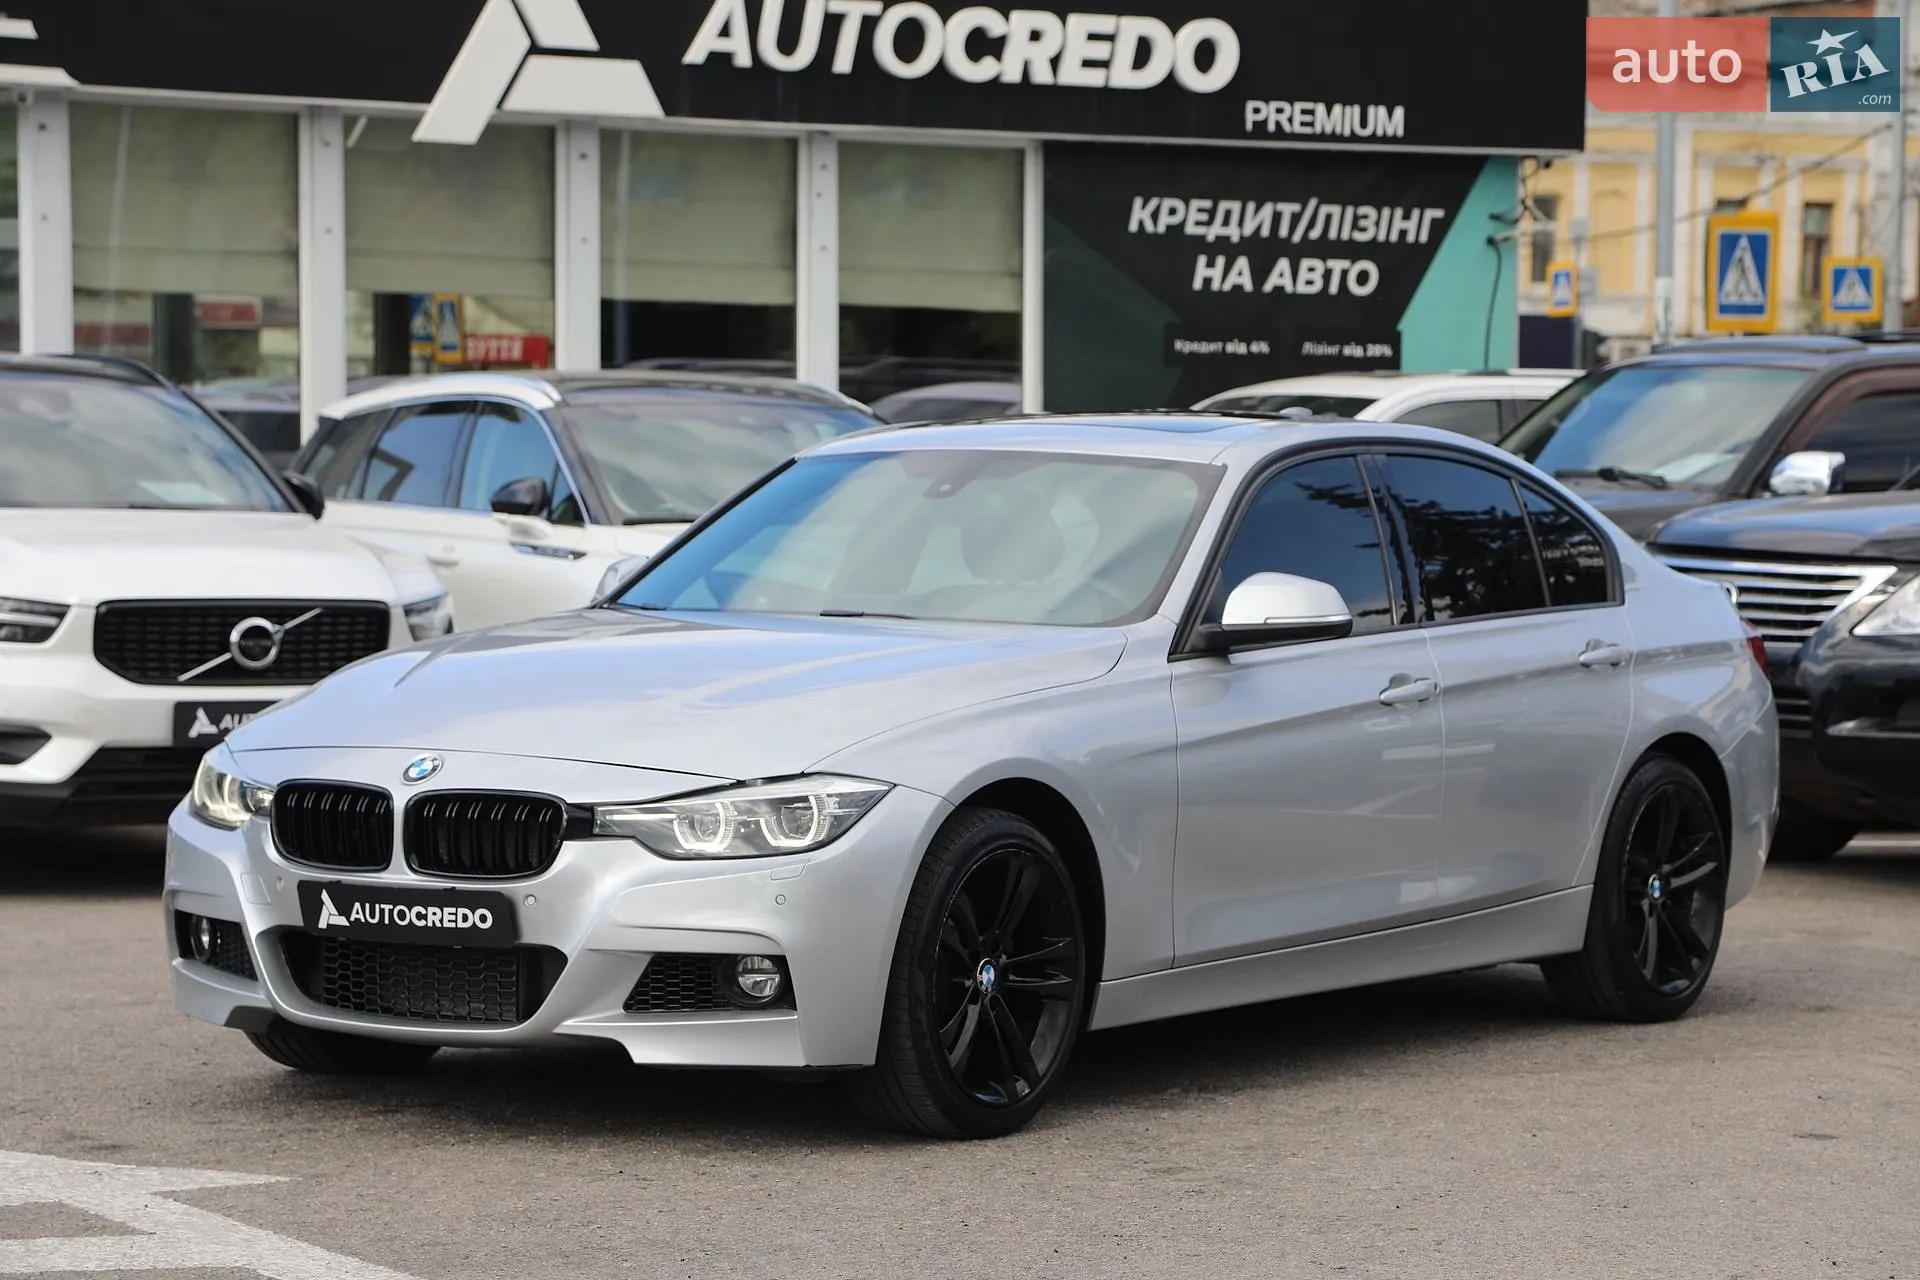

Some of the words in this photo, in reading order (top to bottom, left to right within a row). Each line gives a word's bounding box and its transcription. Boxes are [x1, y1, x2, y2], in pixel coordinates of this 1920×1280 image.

[682, 0, 1240, 93] AUTOCREDO
[1244, 99, 1405, 138] PREMIUM
[1128, 196, 1446, 244] КРЕДИТ/ЛІЗІНГ
[1192, 254, 1254, 293] НА
[1262, 256, 1380, 297] АВТО
[1173, 338, 1224, 355] Кредит
[1225, 338, 1249, 355] від
[1342, 341, 1365, 358] від
[349, 901, 493, 930] AUTOCREDO
